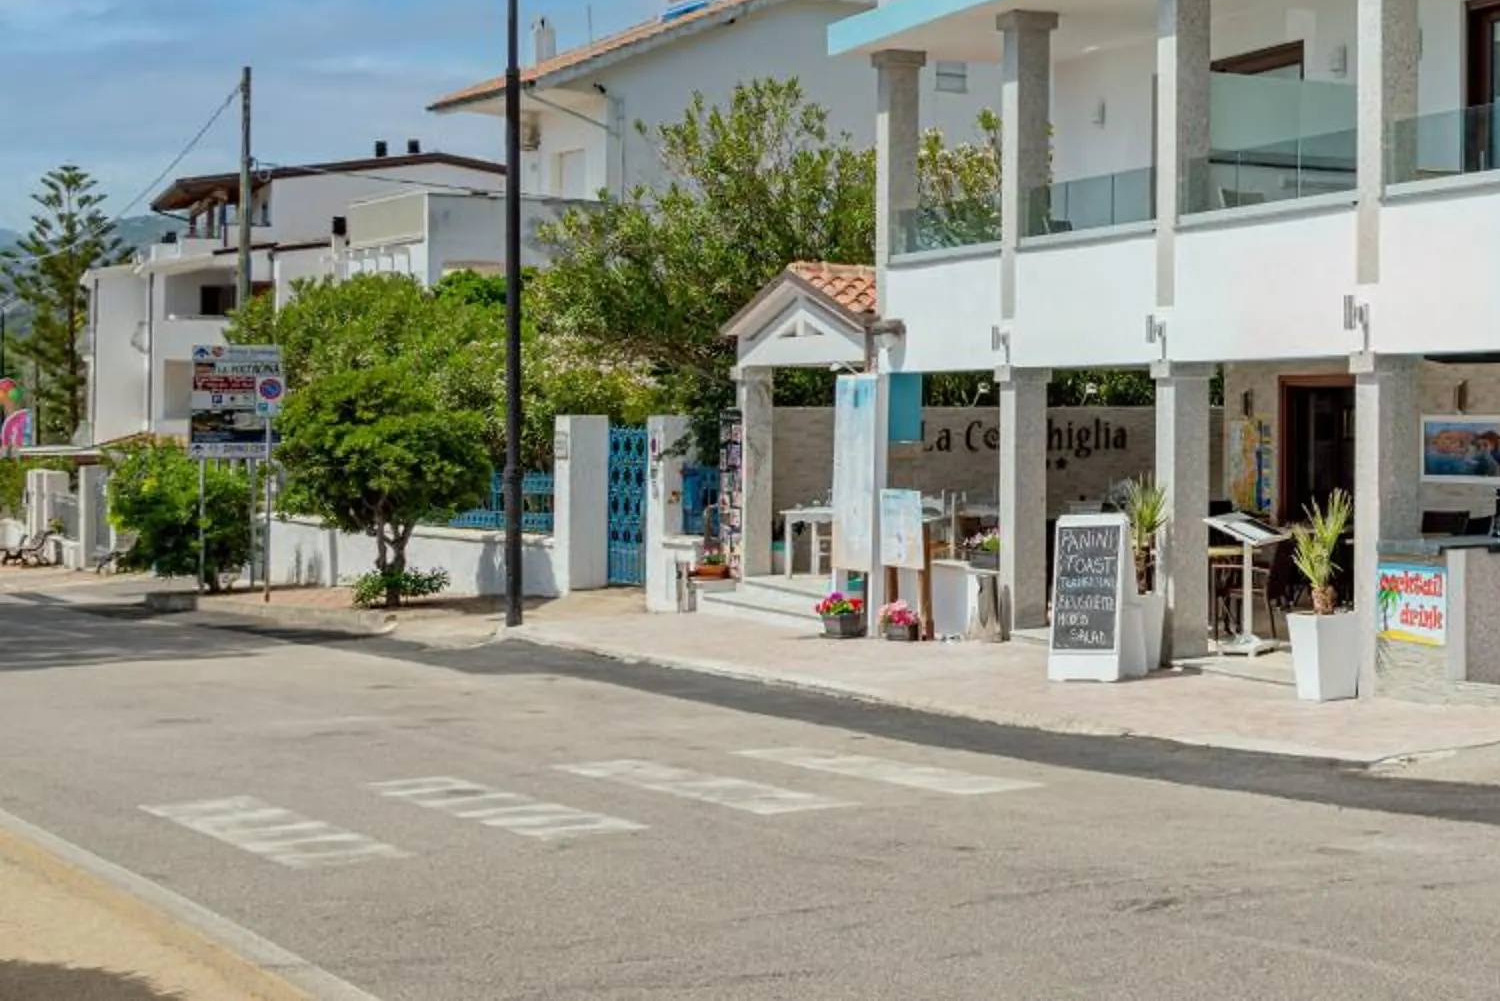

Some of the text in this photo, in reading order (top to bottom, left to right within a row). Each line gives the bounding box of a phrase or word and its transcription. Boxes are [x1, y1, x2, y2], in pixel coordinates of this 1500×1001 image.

[1061, 529, 1113, 552] PANINI
[1066, 555, 1116, 575] TOAST
[1379, 571, 1443, 597] cocktail
[1400, 602, 1443, 630] drink
